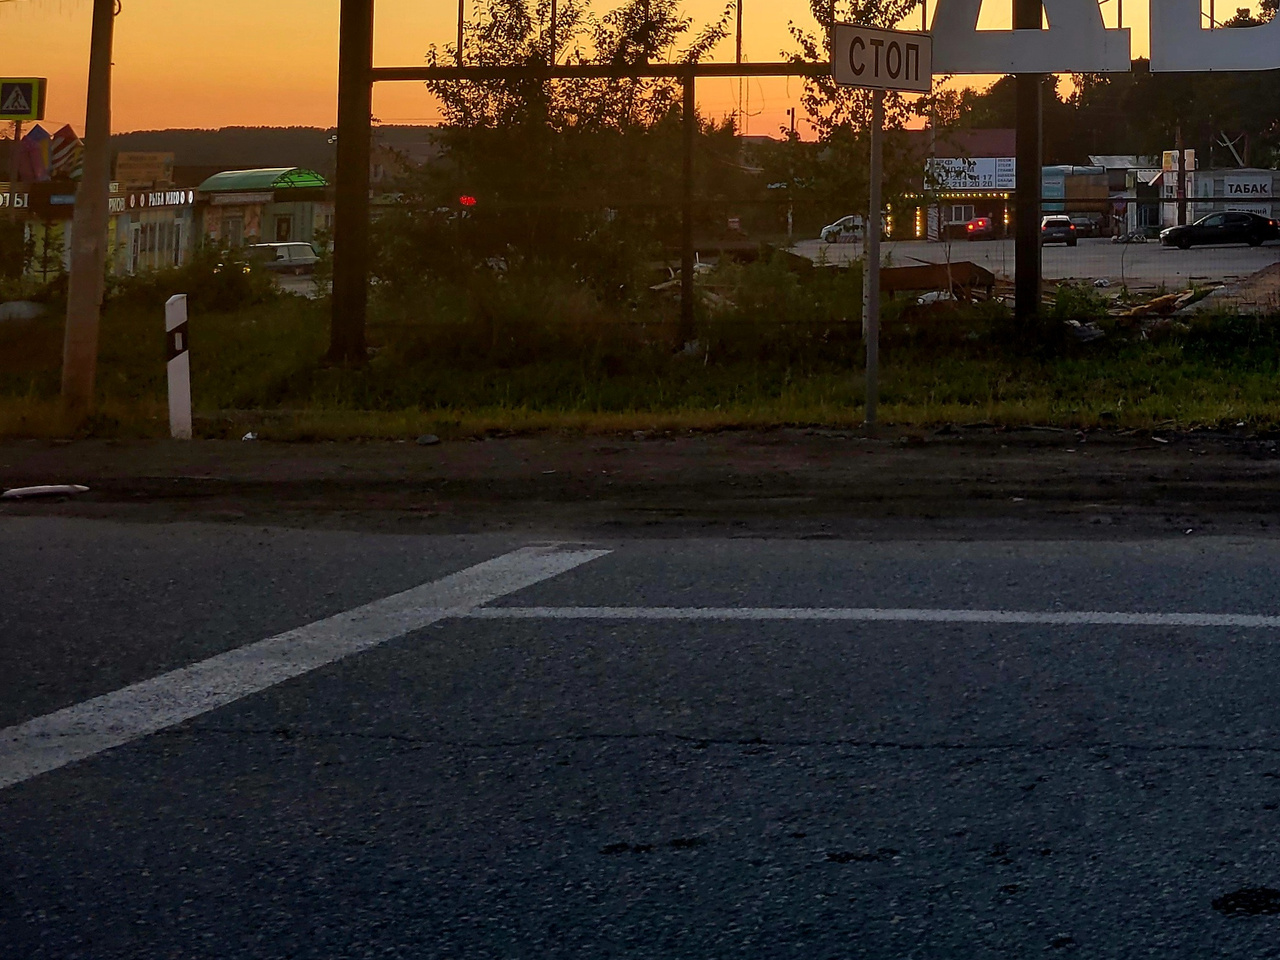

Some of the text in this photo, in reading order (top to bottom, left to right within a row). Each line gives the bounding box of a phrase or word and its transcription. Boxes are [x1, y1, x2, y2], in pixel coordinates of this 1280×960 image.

[849, 36, 919, 81] СТОП
[1228, 183, 1268, 194] ТАБАК
[148, 192, 164, 207] РЫБА
